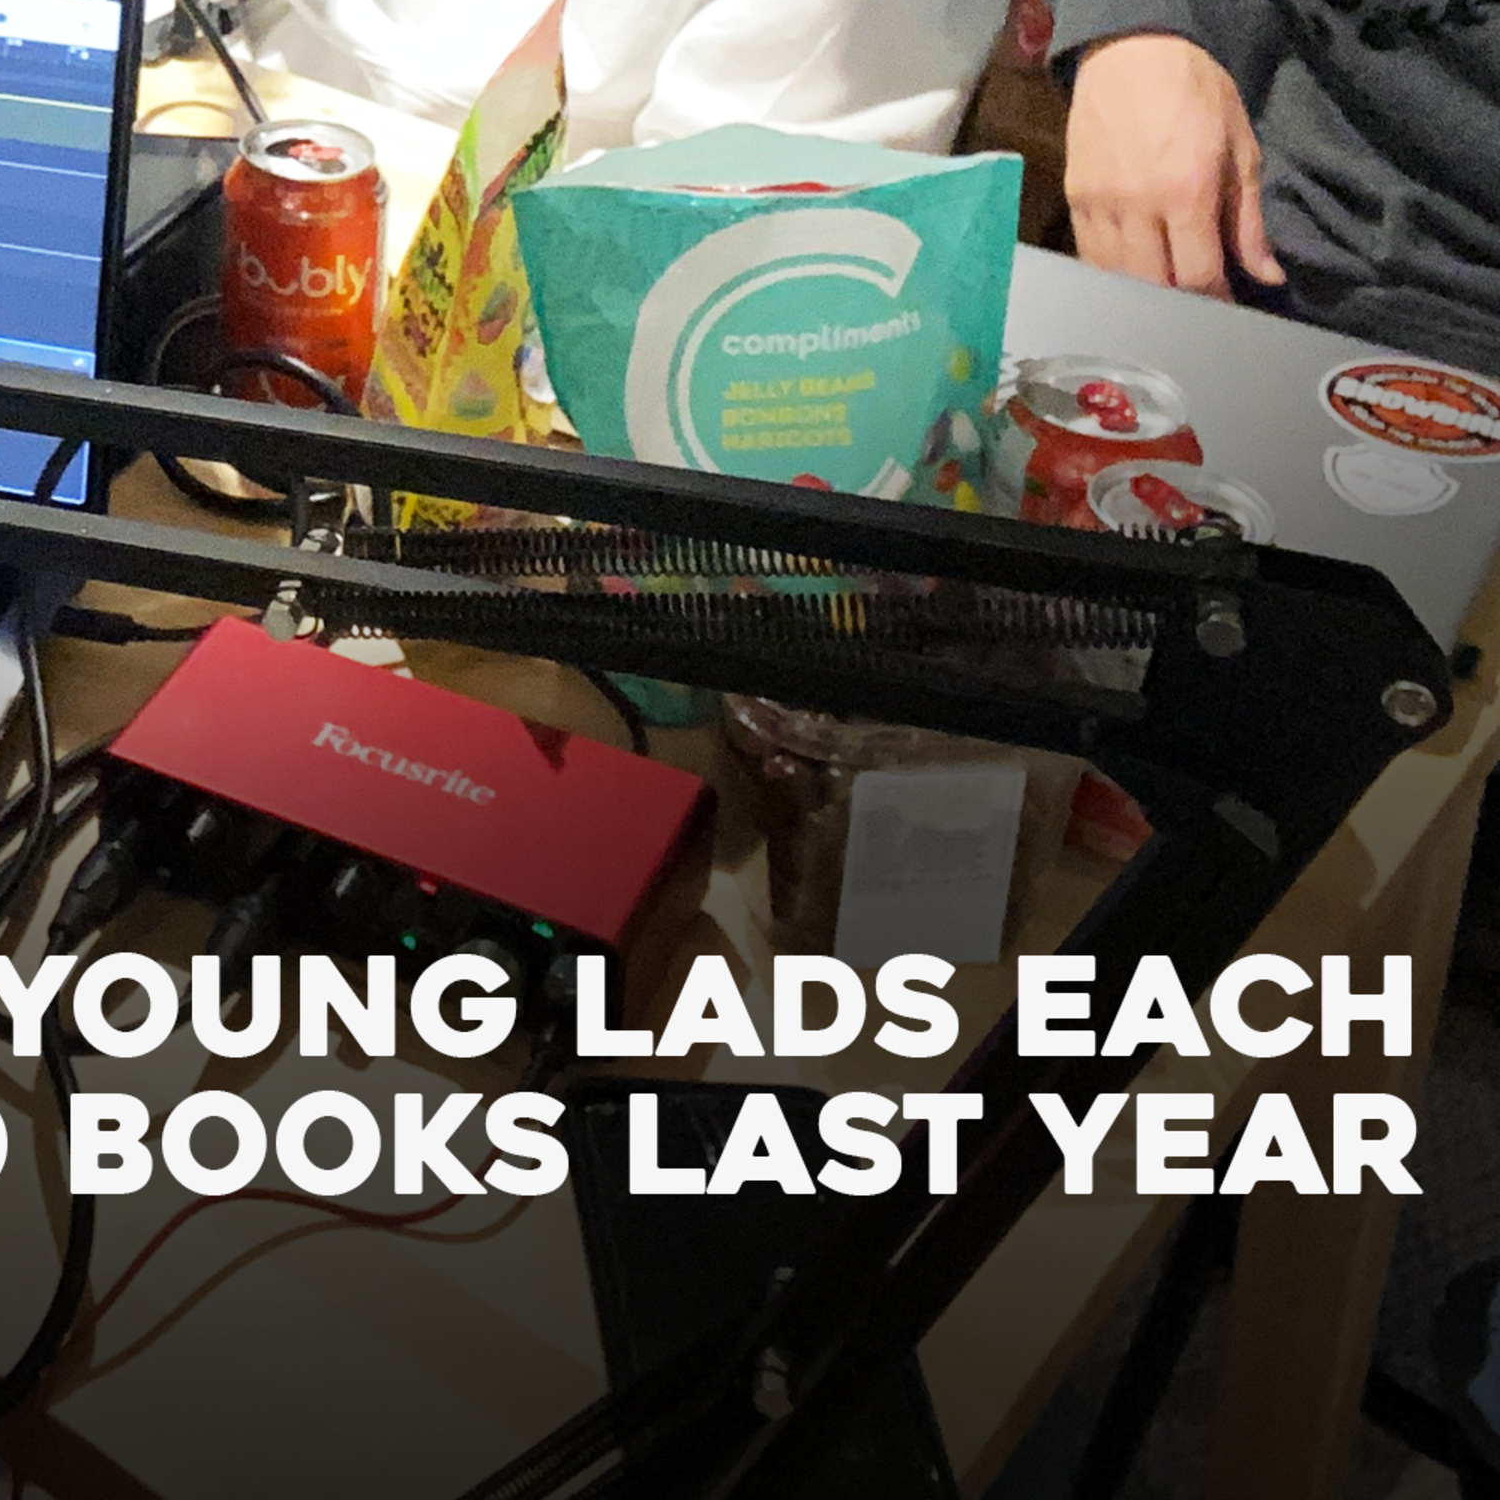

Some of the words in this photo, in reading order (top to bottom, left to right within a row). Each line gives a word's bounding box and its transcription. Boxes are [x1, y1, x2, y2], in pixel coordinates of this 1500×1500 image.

[237, 240, 373, 306] bubly
[721, 310, 921, 360] compliments
[310, 720, 498, 808] Focusrite
